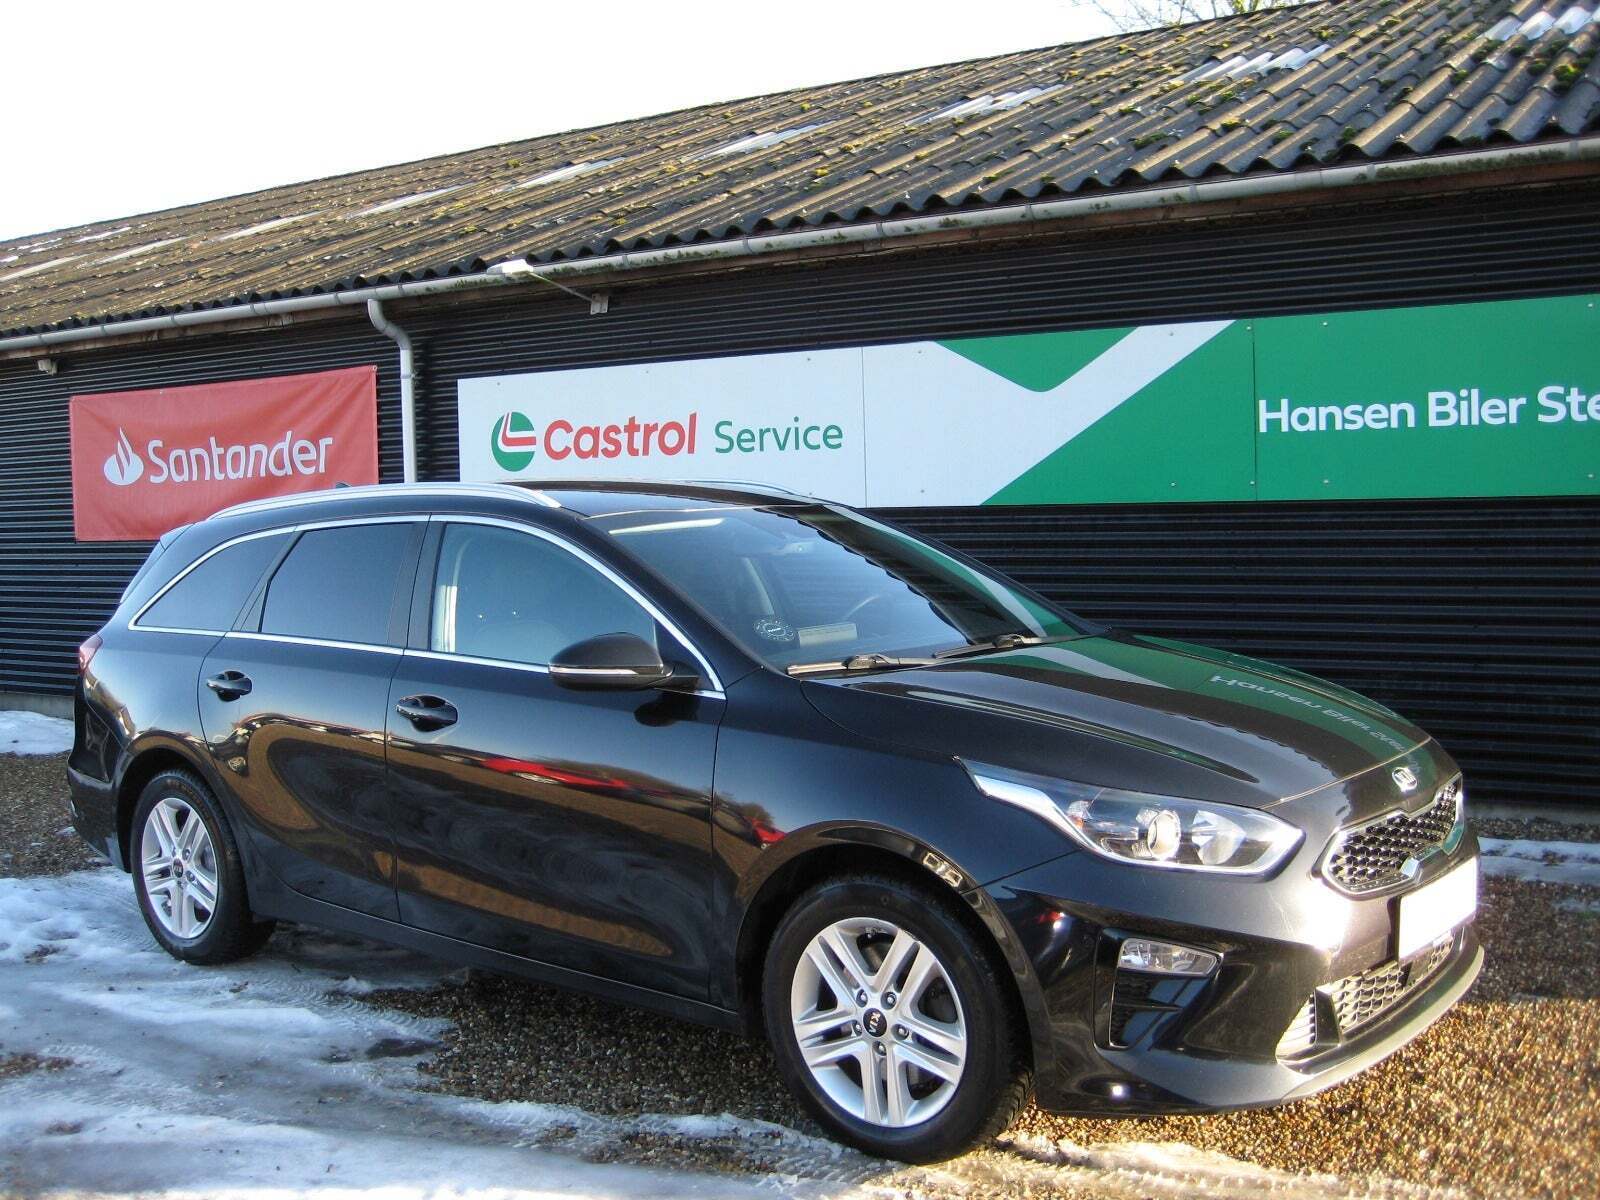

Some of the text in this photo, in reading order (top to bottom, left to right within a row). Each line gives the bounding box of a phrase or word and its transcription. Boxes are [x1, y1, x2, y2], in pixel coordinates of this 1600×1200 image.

[1258, 398, 1416, 433] Hansen
[1427, 388, 1527, 427] Biler
[148, 430, 334, 484] Santander
[544, 412, 844, 460] Castrol Service
